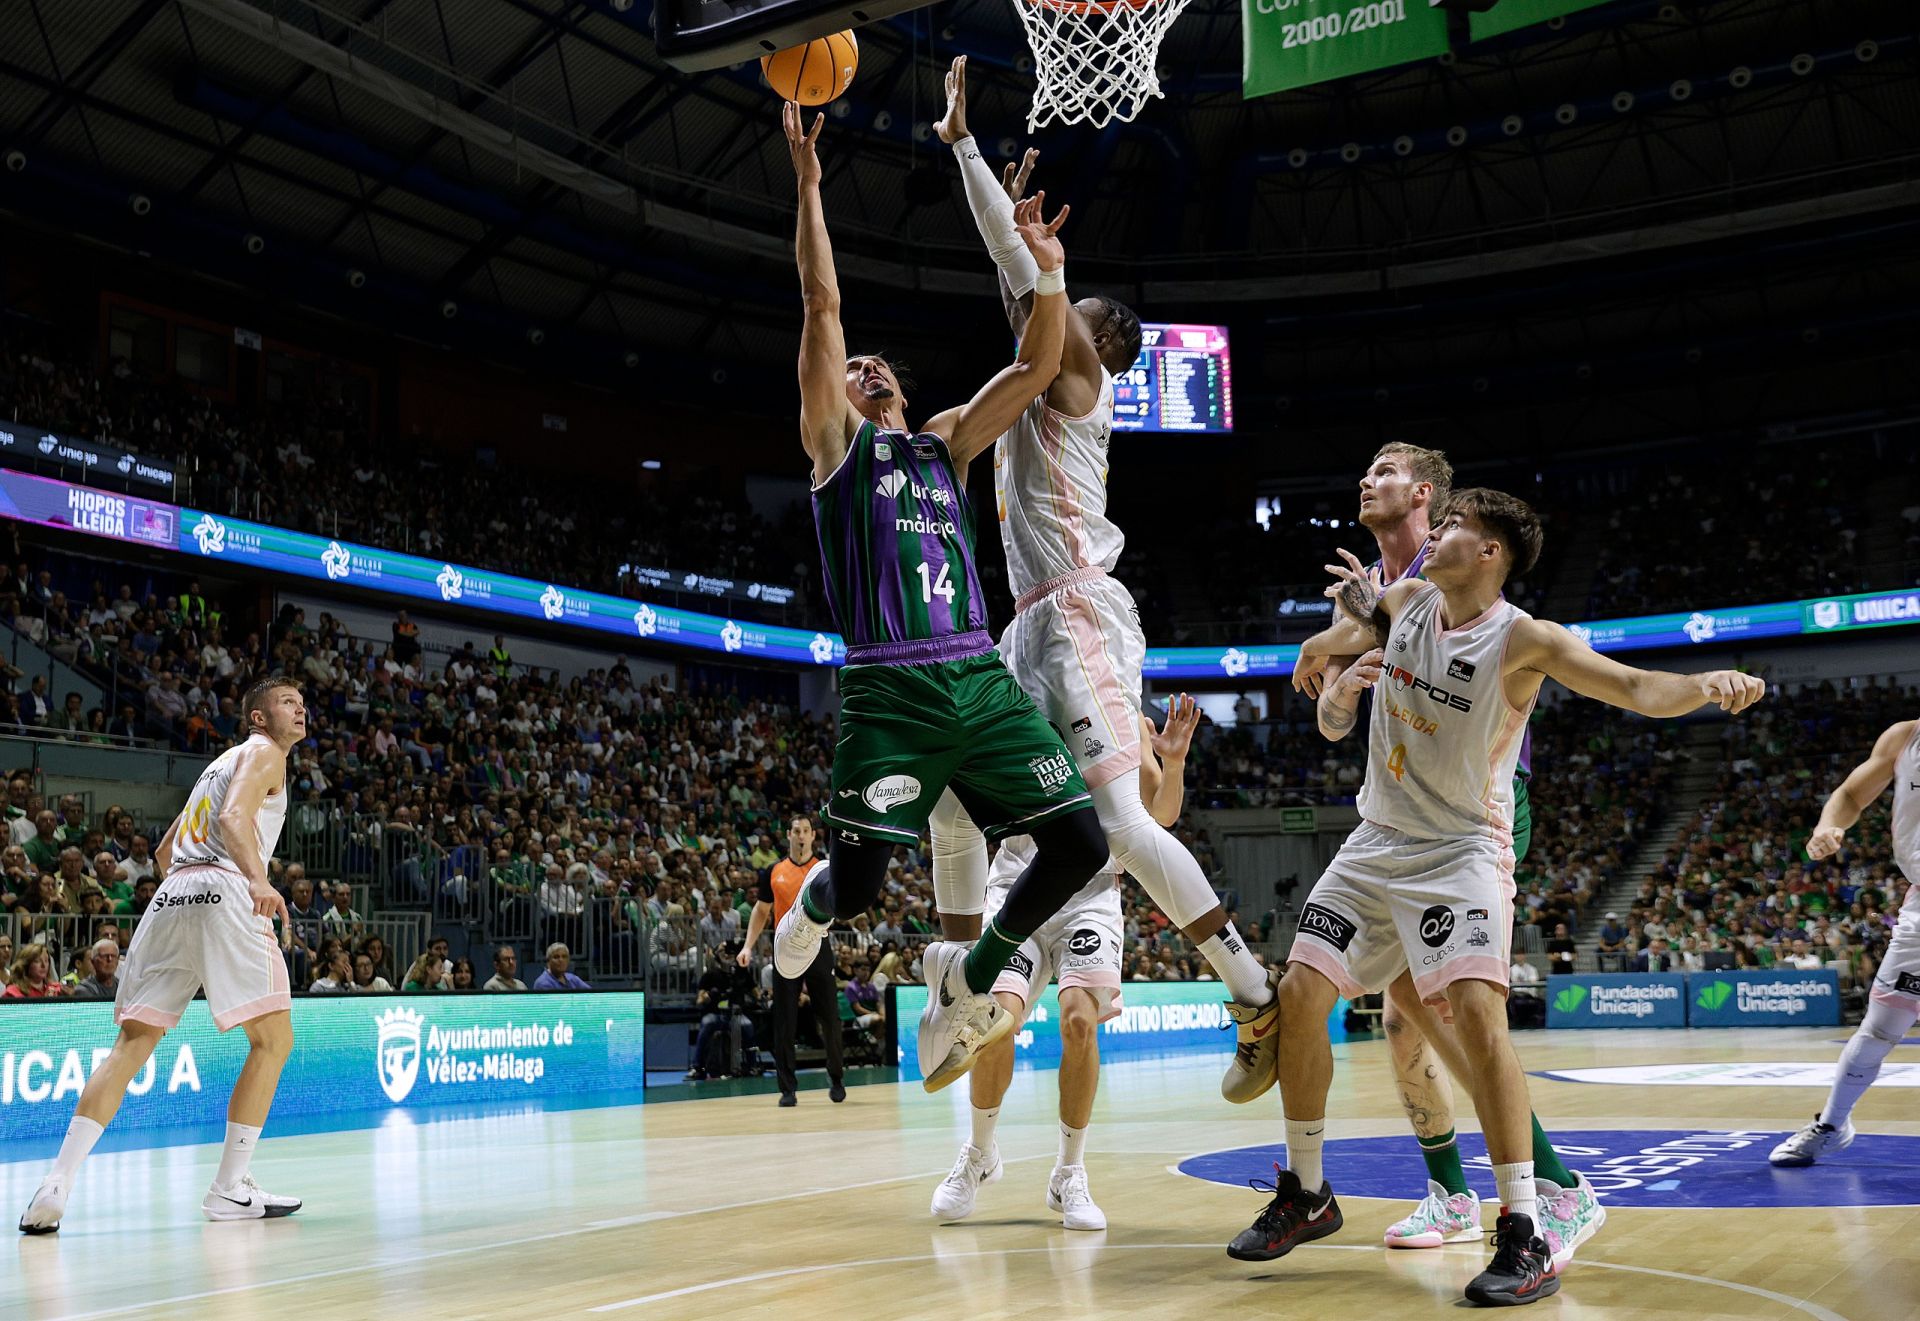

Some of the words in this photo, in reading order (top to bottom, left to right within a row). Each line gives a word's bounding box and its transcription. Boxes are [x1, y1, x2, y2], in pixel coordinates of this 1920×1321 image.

[1281, 0, 1406, 49] 2000/2001
[58, 445, 98, 466] Unicaja
[136, 463, 173, 484] Unicaja
[68, 488, 126, 519] HIOPOS
[73, 508, 125, 537] LLEIDA
[916, 561, 956, 605] 14
[1074, 722, 1088, 733] acb
[1388, 744, 1406, 782] 4
[1036, 765, 1074, 788] laga
[168, 890, 222, 907] serveto
[1304, 910, 1344, 938] PONS
[1421, 911, 1454, 938] Q2
[1069, 934, 1099, 949] Q2
[1224, 938, 1242, 956] NIKE
[1591, 984, 1679, 1000] Fundación
[1737, 980, 1832, 997] Fundación
[1161, 1003, 1221, 1031] DEDICADO
[1591, 999, 1654, 1018] Unicaja
[1737, 996, 1806, 1015] Unicaja
[426, 1021, 550, 1057] Ayuntamiento
[553, 1019, 574, 1046] de
[167, 1043, 202, 1093] A
[426, 1052, 544, 1084] Vélez-Málaga
